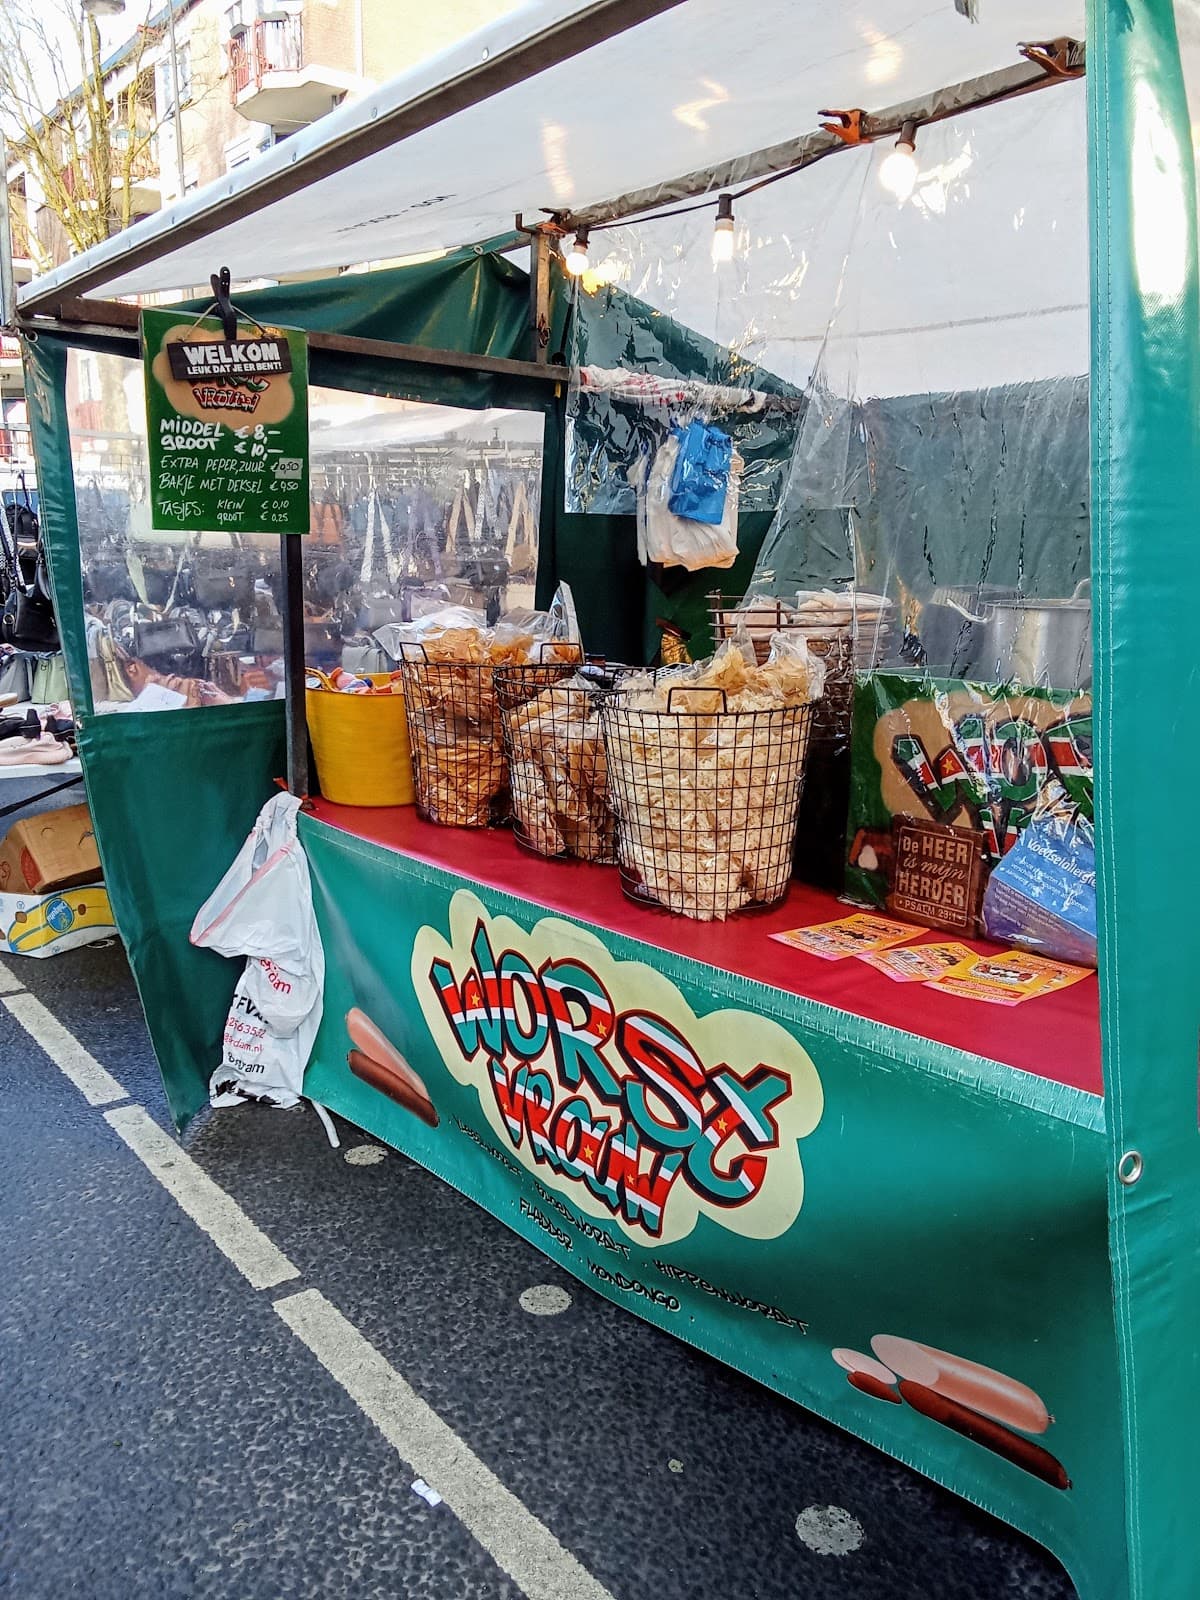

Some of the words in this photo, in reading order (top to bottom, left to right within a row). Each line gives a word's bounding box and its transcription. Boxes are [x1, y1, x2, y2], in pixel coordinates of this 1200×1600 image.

[183, 342, 280, 365] WELKOM
[187, 365, 211, 375] LEUK
[213, 364, 231, 373] DAT
[232, 363, 242, 372] JE
[244, 362, 255, 371] ER
[256, 361, 282, 370] BENT!
[160, 455, 199, 469] EXTRA
[200, 477, 225, 491] MET
[227, 479, 263, 493] DEKSEL
[902, 836, 919, 854] De
[922, 836, 968, 864] HEER
[903, 854, 917, 869] is
[920, 861, 966, 882] mijn
[898, 871, 965, 907] HERDER
[904, 900, 935, 915] PSALM
[429, 917, 792, 1208] WORST
[488, 1054, 685, 1238] VROUW
